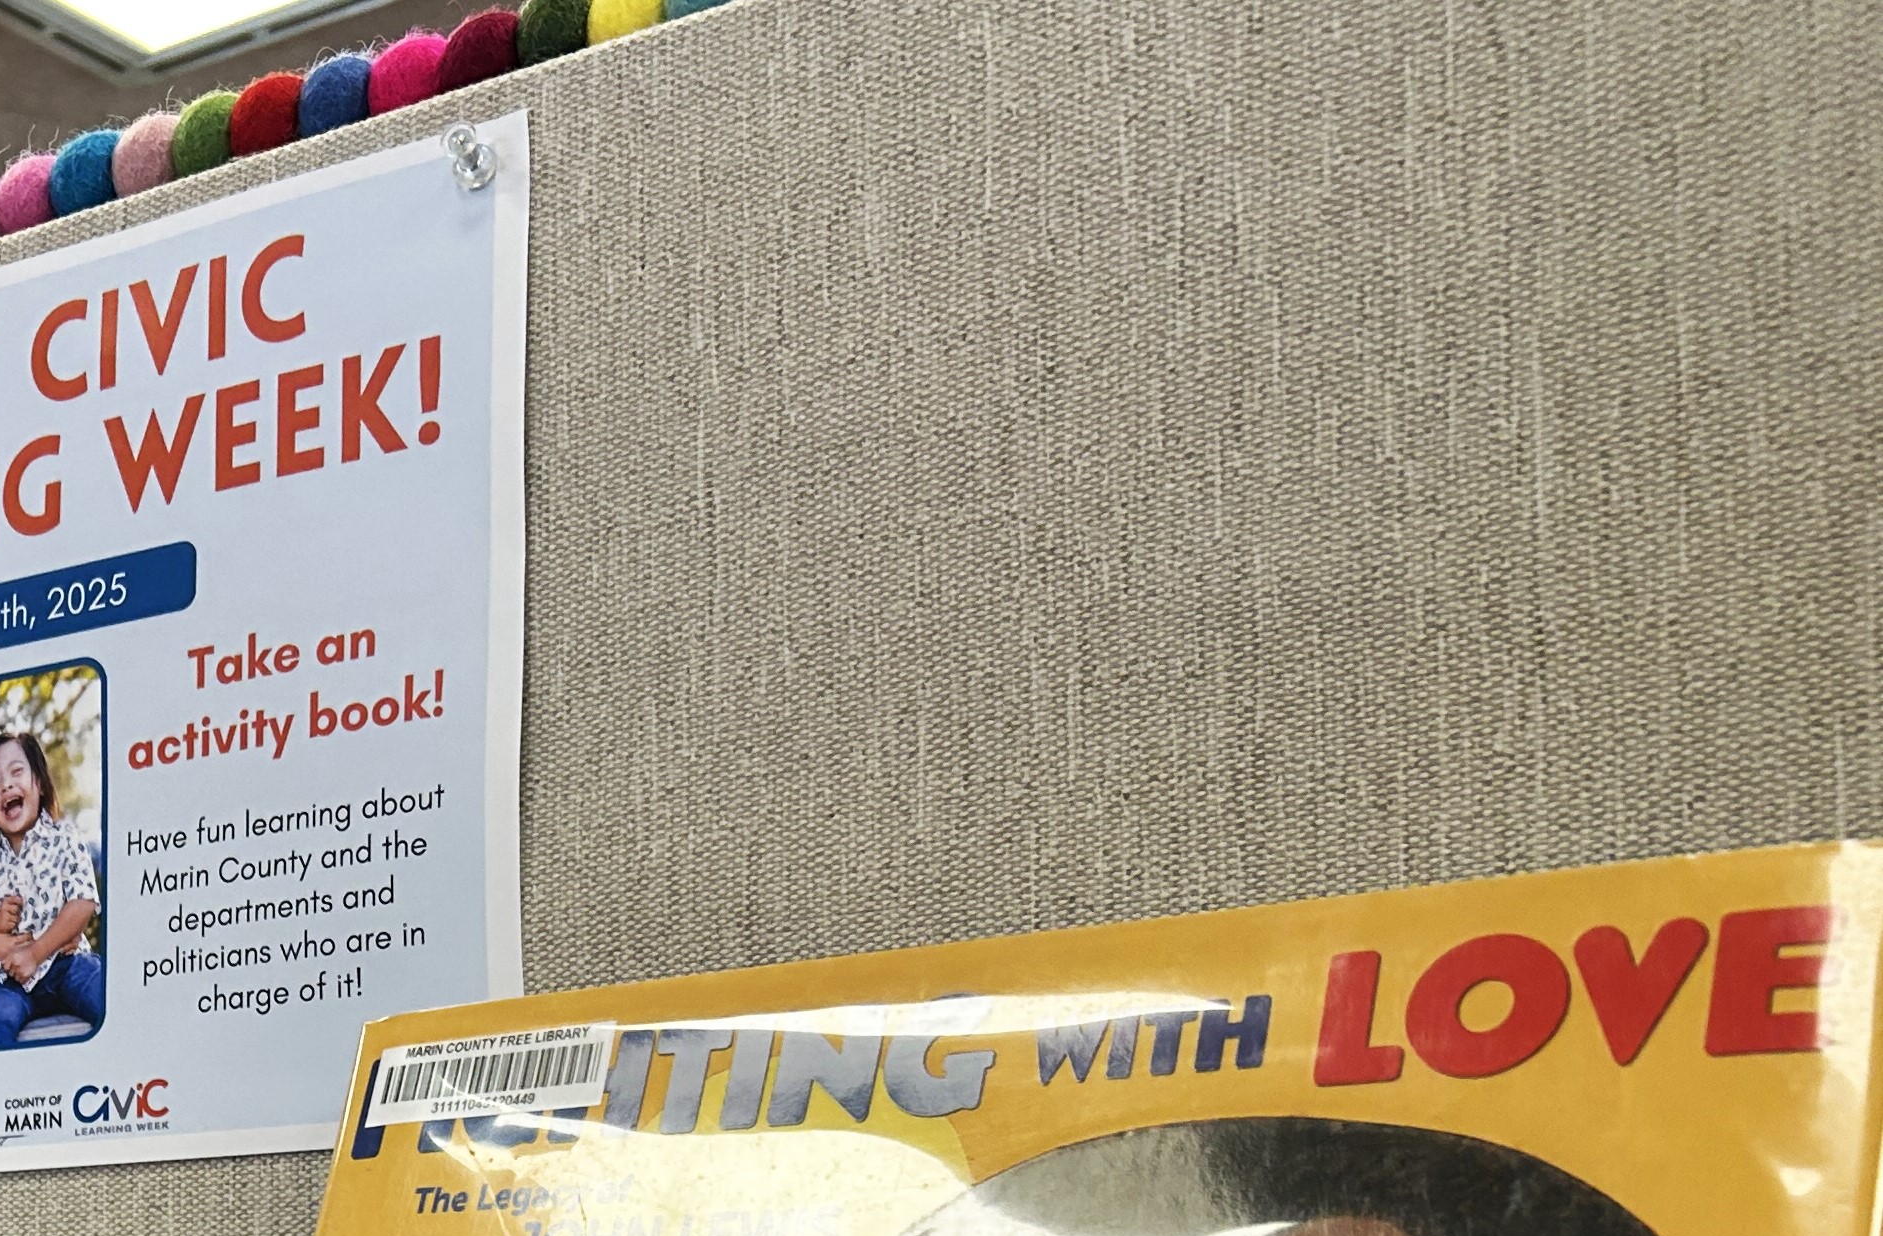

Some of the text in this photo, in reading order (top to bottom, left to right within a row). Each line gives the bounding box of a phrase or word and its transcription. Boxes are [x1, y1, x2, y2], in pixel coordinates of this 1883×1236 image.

[31, 234, 307, 402] CIVIC
[104, 335, 443, 514] WEEK!
[46, 572, 128, 621] 2025
[187, 628, 376, 689] Take an
[128, 670, 444, 770] activity book!
[127, 784, 445, 856] Have fun learning about
[140, 830, 426, 896] Marin County and the
[168, 875, 394, 937] departments and
[143, 923, 425, 986] politicians who are in
[198, 966, 363, 1014] charge of it!
[1313, 906, 1838, 1087] LOVE
[406, 1026, 591, 1060] MARIN COUNTY FREE LIBRARY
[5, 1095, 62, 1109] COUNTY OF
[5, 1111, 63, 1133] MARIN
[75, 1121, 169, 1136] LEARNING WEEK
[415, 1186, 468, 1214] The
